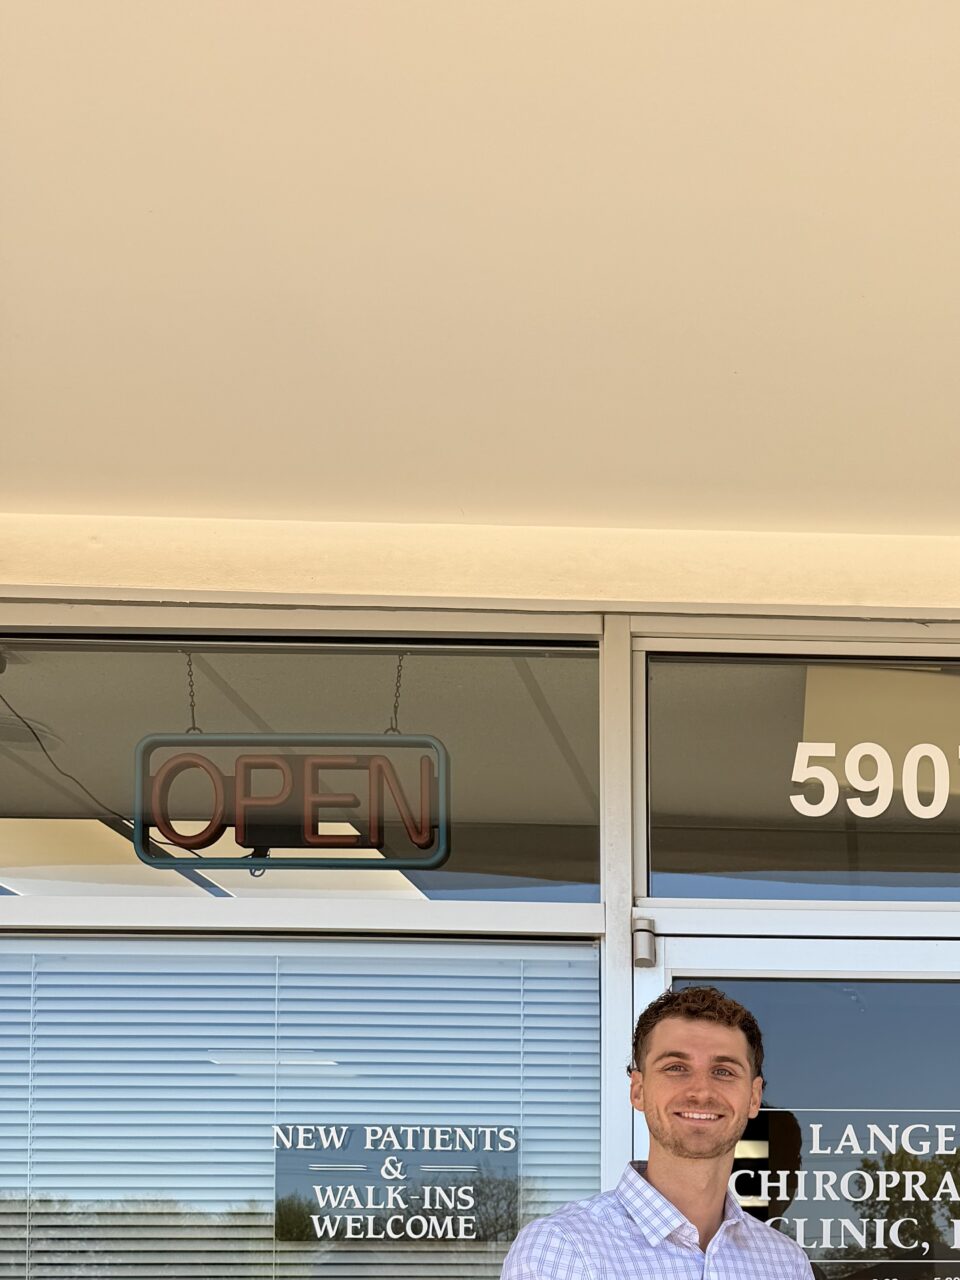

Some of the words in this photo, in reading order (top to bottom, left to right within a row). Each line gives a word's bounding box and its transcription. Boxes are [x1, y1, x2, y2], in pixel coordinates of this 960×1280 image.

[152, 753, 433, 850] OPEN
[272, 1125, 349, 1150] NEW
[364, 1126, 517, 1151] PATIENTS
[380, 1156, 407, 1180] &
[312, 1185, 476, 1210] WALK-INS
[310, 1215, 478, 1239] WELCOME
